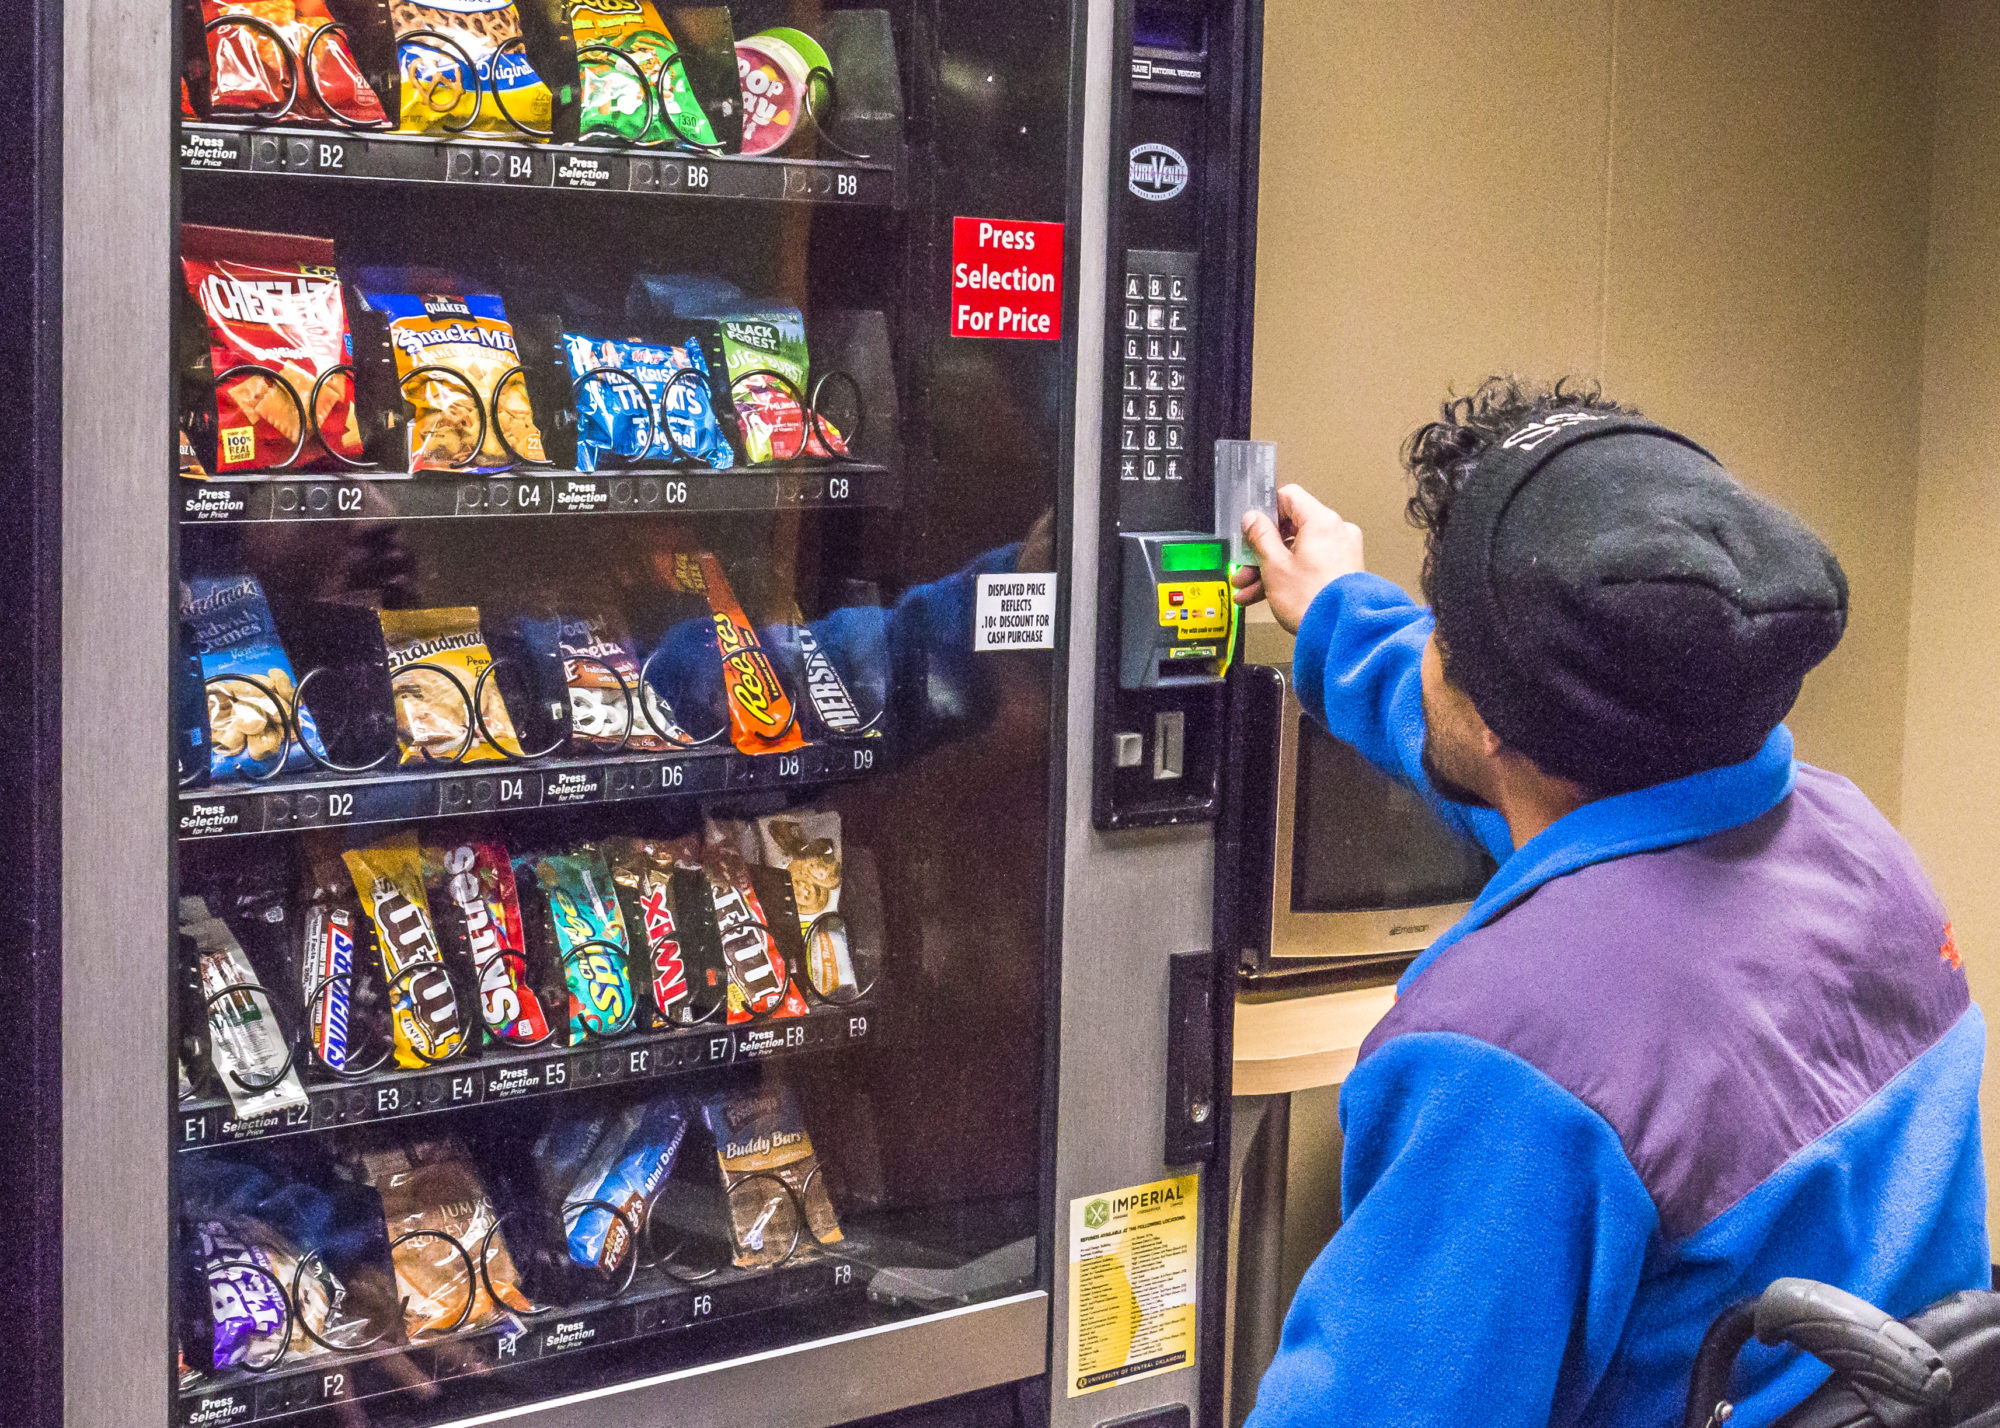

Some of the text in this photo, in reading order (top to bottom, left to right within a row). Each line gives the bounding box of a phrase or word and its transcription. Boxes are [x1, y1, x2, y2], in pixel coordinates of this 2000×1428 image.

[1131, 64, 1149, 74] RANE
[190, 134, 224, 147] Press
[181, 145, 237, 159] Selection
[319, 145, 343, 168] B2
[509, 155, 532, 178] B4
[569, 156, 598, 169] Press
[558, 166, 609, 180] Selection
[687, 166, 708, 187] B6
[837, 175, 857, 195] B8
[979, 222, 1035, 250] Press
[955, 262, 1054, 292] Selection
[1128, 280, 1137, 295] A
[1151, 280, 1159, 295] B
[1172, 280, 1181, 296] C
[424, 302, 471, 315] QUAKER
[958, 304, 1051, 333] For Price
[1128, 310, 1136, 326] D
[1172, 311, 1180, 327] F
[726, 322, 773, 338] BLACK
[398, 323, 478, 356] Snack
[727, 331, 776, 350] FOREST
[1128, 340, 1136, 356] G
[1150, 340, 1158, 356] H
[1172, 341, 1179, 357] J
[1129, 371, 1135, 386] 1
[1171, 371, 1178, 386] 3
[1126, 401, 1134, 416] 4
[1149, 401, 1156, 416] 5
[1170, 401, 1177, 416] 6
[1126, 431, 1133, 446] 7
[1148, 431, 1155, 446] 8
[1169, 431, 1177, 446] 9
[1147, 460, 1154, 476] 0
[1168, 461, 1176, 476] #
[198, 489, 230, 499] Press
[518, 485, 541, 506] C4
[568, 482, 596, 493] Press
[666, 481, 687, 502] C6
[829, 478, 849, 499] C8
[338, 489, 362, 510] C2
[557, 492, 607, 502] Selection
[186, 500, 243, 511] Selection
[988, 583, 1046, 596] DISPLAYED PRICE
[1001, 599, 1032, 612] REFLECTS
[1000, 615, 1034, 628] DISCOUNT
[1036, 614, 1050, 627] FOR
[987, 630, 1043, 644] CASH PURCHASE
[779, 757, 799, 776] D8
[854, 750, 873, 769] D9
[558, 774, 587, 785] Press
[662, 766, 683, 787] D6
[501, 779, 523, 801] D4
[548, 782, 597, 794] Selection
[193, 805, 225, 815] Press
[329, 794, 353, 817] D2
[180, 814, 238, 828] Selection
[640, 888, 689, 1016] TWIX
[326, 933, 354, 1072] SNICKERS
[402, 1015, 426, 1051] PEANUT
[748, 1029, 774, 1041] Press
[849, 1018, 867, 1036] E9
[739, 1037, 784, 1052] Selection
[786, 1026, 804, 1047] E8
[710, 1038, 728, 1059] E7
[499, 1067, 529, 1079] Press
[545, 1064, 565, 1085] E5
[452, 1078, 473, 1100] E4
[489, 1075, 540, 1091] Selection
[377, 1088, 400, 1110] E3
[185, 1117, 206, 1141] E1
[222, 1115, 279, 1133] Selection
[726, 1136, 771, 1159] Buddy
[772, 1131, 801, 1147] Bars
[644, 1162, 664, 1193] Mini
[1112, 1185, 1184, 1214] IMPERIAL
[835, 1265, 852, 1285] F8
[693, 1295, 711, 1316] F6
[556, 1320, 584, 1334] Press
[547, 1328, 595, 1346] Selection
[498, 1336, 517, 1359] F4
[1087, 1353, 1185, 1384] UNIVERSITY OF CENTRAL OKLAHOMA
[324, 1374, 344, 1396] F2
[202, 1396, 233, 1410] Press
[190, 1407, 246, 1424] Selection
